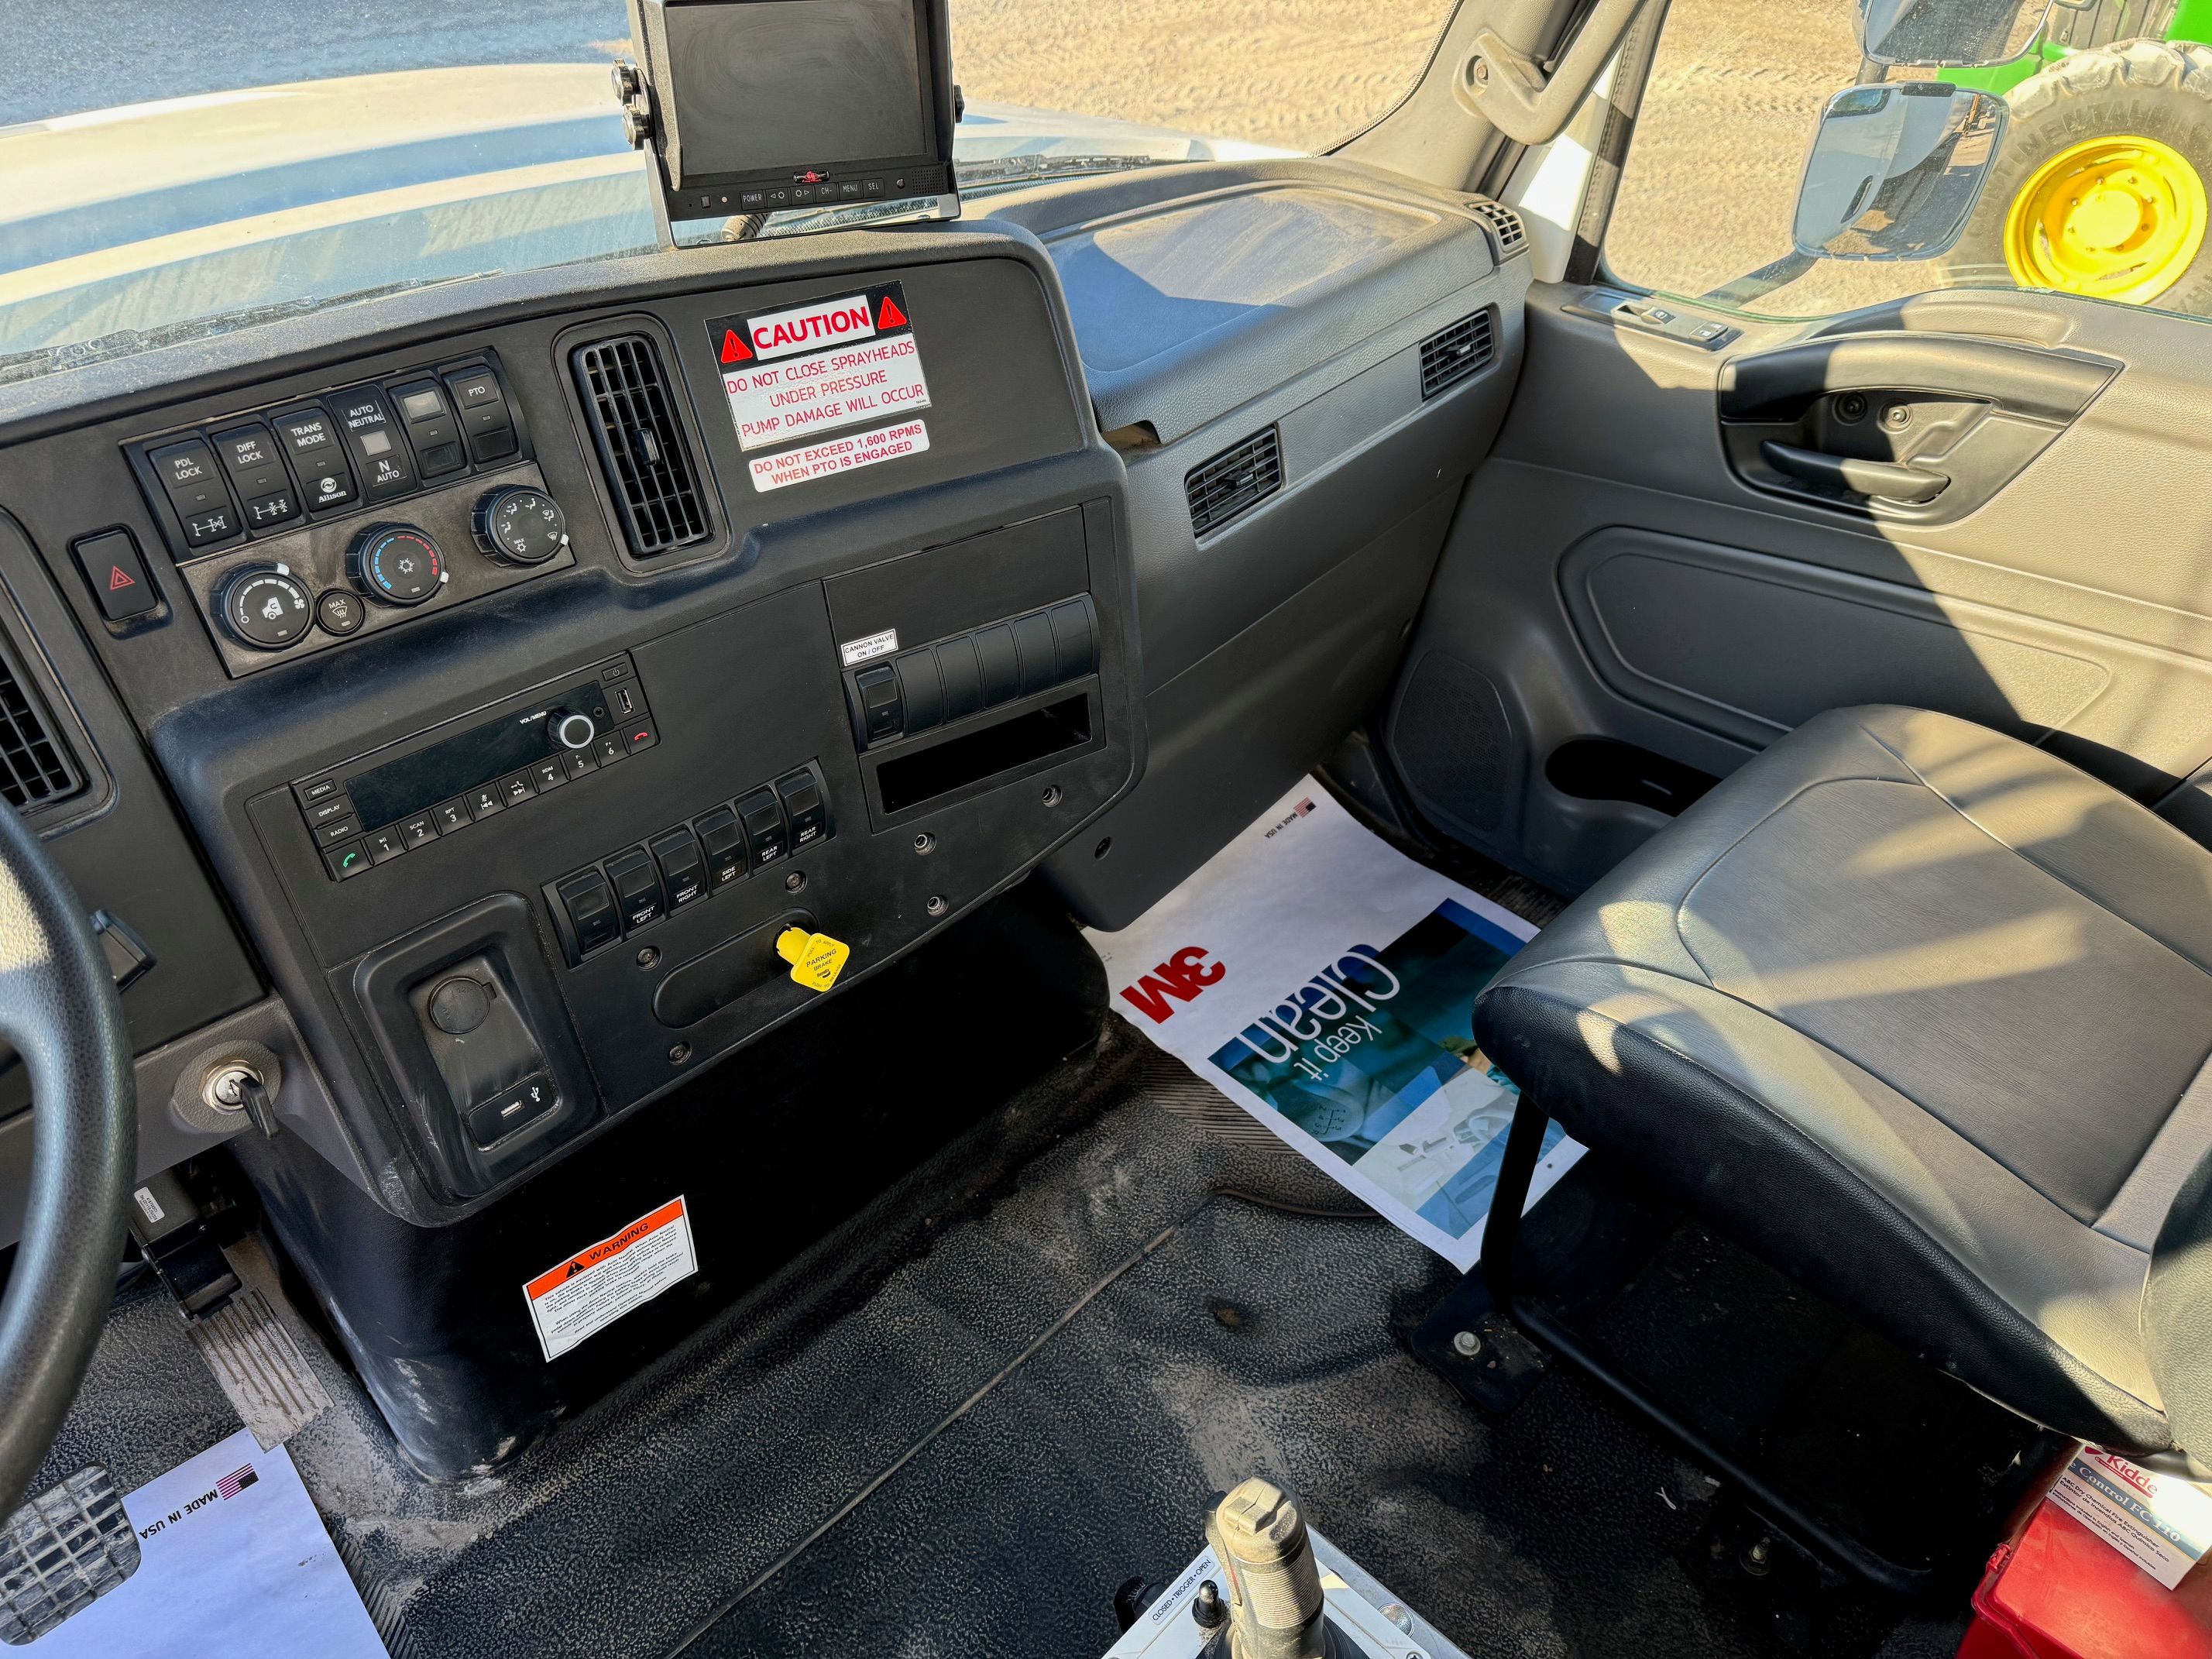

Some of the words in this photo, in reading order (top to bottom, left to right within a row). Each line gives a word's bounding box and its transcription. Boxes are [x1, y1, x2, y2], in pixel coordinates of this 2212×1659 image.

[843, 184, 857, 192] MENU
[868, 182, 879, 191] SEL
[743, 194, 762, 203] POWER
[753, 307, 870, 349] CAUTION
[728, 379, 747, 394] DO
[752, 371, 779, 387] NOT
[786, 361, 827, 380] CLOSE
[832, 342, 915, 370] SPRAYHEADS
[469, 386, 485, 397] PTO
[770, 386, 816, 407] UNDER
[822, 370, 887, 396] PRESSURE
[350, 404, 374, 417] AUTO
[742, 417, 780, 437] PUMP
[785, 403, 842, 428] DAMAGE
[846, 395, 877, 412] WILL
[881, 384, 923, 404] OCCUR
[349, 414, 384, 428] NEUTRAL
[290, 423, 322, 438] TRANS
[297, 432, 325, 447] MODE
[237, 441, 257, 454] DIFF
[754, 461, 773, 474] DO
[776, 455, 802, 469] NOT
[805, 441, 854, 462] EXCEED
[857, 434, 886, 449] 1,600
[889, 424, 922, 441] RPMS
[237, 450, 263, 464] LOCK
[771, 467, 809, 485] WHEN
[814, 460, 836, 474] PTO
[840, 457, 851, 467] IS
[854, 441, 912, 463] ENGAGED
[175, 459, 194, 469] PDL
[379, 462, 390, 472] N
[175, 466, 202, 479] LOCK
[377, 469, 399, 482] AUTO
[318, 490, 346, 503] Allison
[329, 599, 345, 610] MAX
[845, 640, 872, 653] CANNON
[874, 634, 894, 644] VALVE
[520, 711, 547, 725] VOL/MENU
[609, 747, 614, 755] 6
[548, 773, 554, 781] 4
[311, 785, 330, 795] MEDIA
[318, 805, 341, 817] DISPLAY
[451, 813, 457, 823] 3
[1282, 812, 1298, 825] MADE
[330, 826, 349, 836] RADIO
[409, 821, 424, 831] SCAN
[801, 826, 816, 838] REAR
[417, 829, 424, 837] 2
[800, 831, 816, 843] RIGHT
[1265, 829, 1277, 839] USA
[761, 846, 778, 857] REAR
[763, 851, 777, 862] LEFT
[722, 867, 735, 877] SIDE
[722, 872, 736, 882] LEFT
[676, 884, 697, 899] FRONT
[678, 891, 697, 903] RIGHT
[633, 906, 654, 921] FRONT
[637, 913, 652, 924] LEFT
[806, 949, 836, 967] PARKING
[814, 959, 832, 971] BRAKE
[1119, 946, 1226, 1024] 3M
[1237, 950, 1400, 1063] Clean
[1314, 1015, 1382, 1063] Keep
[1293, 1058, 1328, 1080] it
[589, 1223, 648, 1260] WARNING
[2107, 1455, 2158, 1494] Kidde
[186, 1489, 218, 1515] MADE
[2080, 1468, 2129, 1506] Control
[2130, 1503, 2152, 1521] FC
[2153, 1522, 2181, 1541] 110
[168, 1510, 182, 1523] IN
[2062, 1477, 2075, 1487] ABC
[2076, 1486, 2085, 1494] Dry
[2087, 1494, 2111, 1513] Chemical
[2112, 1513, 2122, 1522] Fire
[2124, 1521, 2159, 1547] Extinguisher
[2060, 1480, 2082, 1497] Extintor
[2091, 1503, 2117, 1523] Incendios
[2118, 1523, 2131, 1534] ABC
[2155, 1551, 2169, 1562] Seco
[139, 1520, 166, 1540] USA
[1152, 1599, 1173, 1620] CLOSED
[1173, 1576, 1195, 1599] TRIGGER
[1196, 1559, 1211, 1575] OPEN
